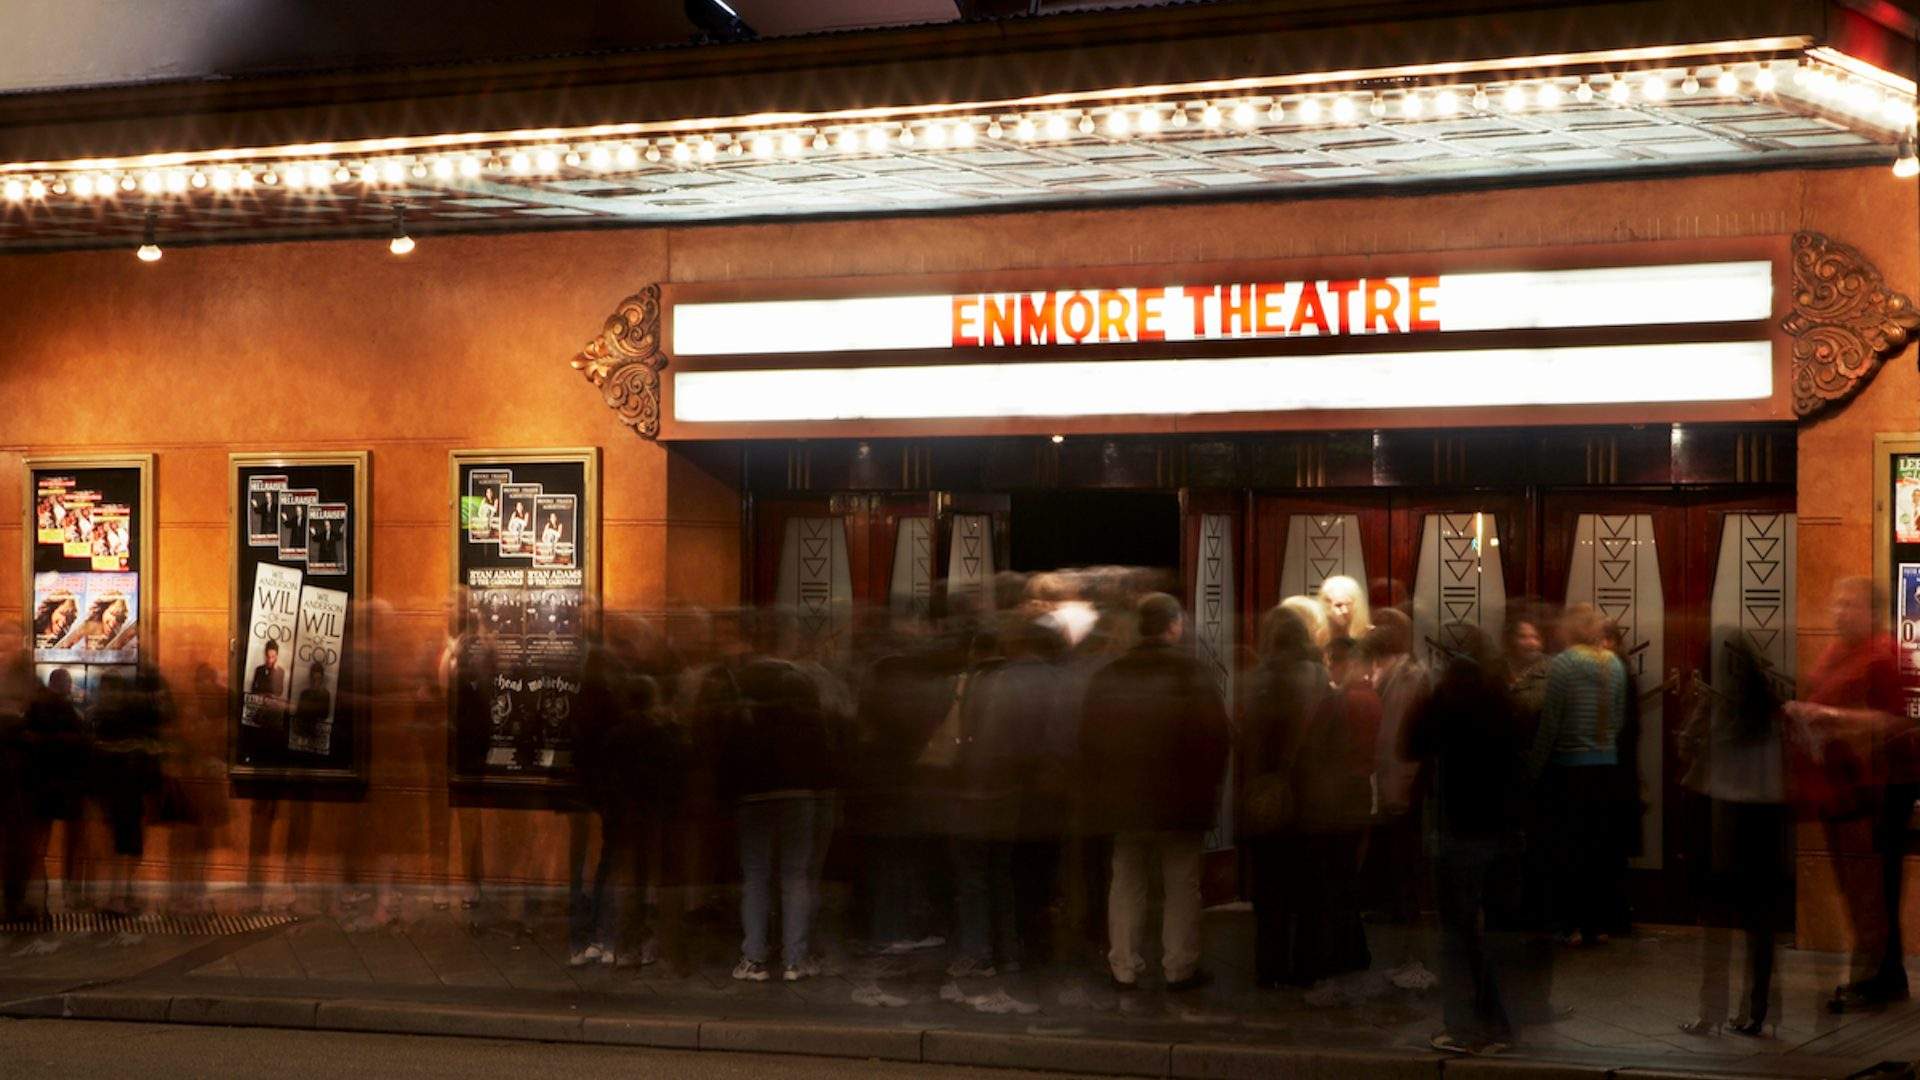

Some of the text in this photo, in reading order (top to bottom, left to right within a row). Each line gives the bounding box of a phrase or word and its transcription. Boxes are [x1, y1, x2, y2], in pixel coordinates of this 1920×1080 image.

[951, 276, 1440, 347] ENMORE THEATRE
[258, 586, 295, 616] WIL
[253, 621, 292, 643] GOD
[303, 609, 341, 638] WIL
[298, 644, 338, 666] GOD
